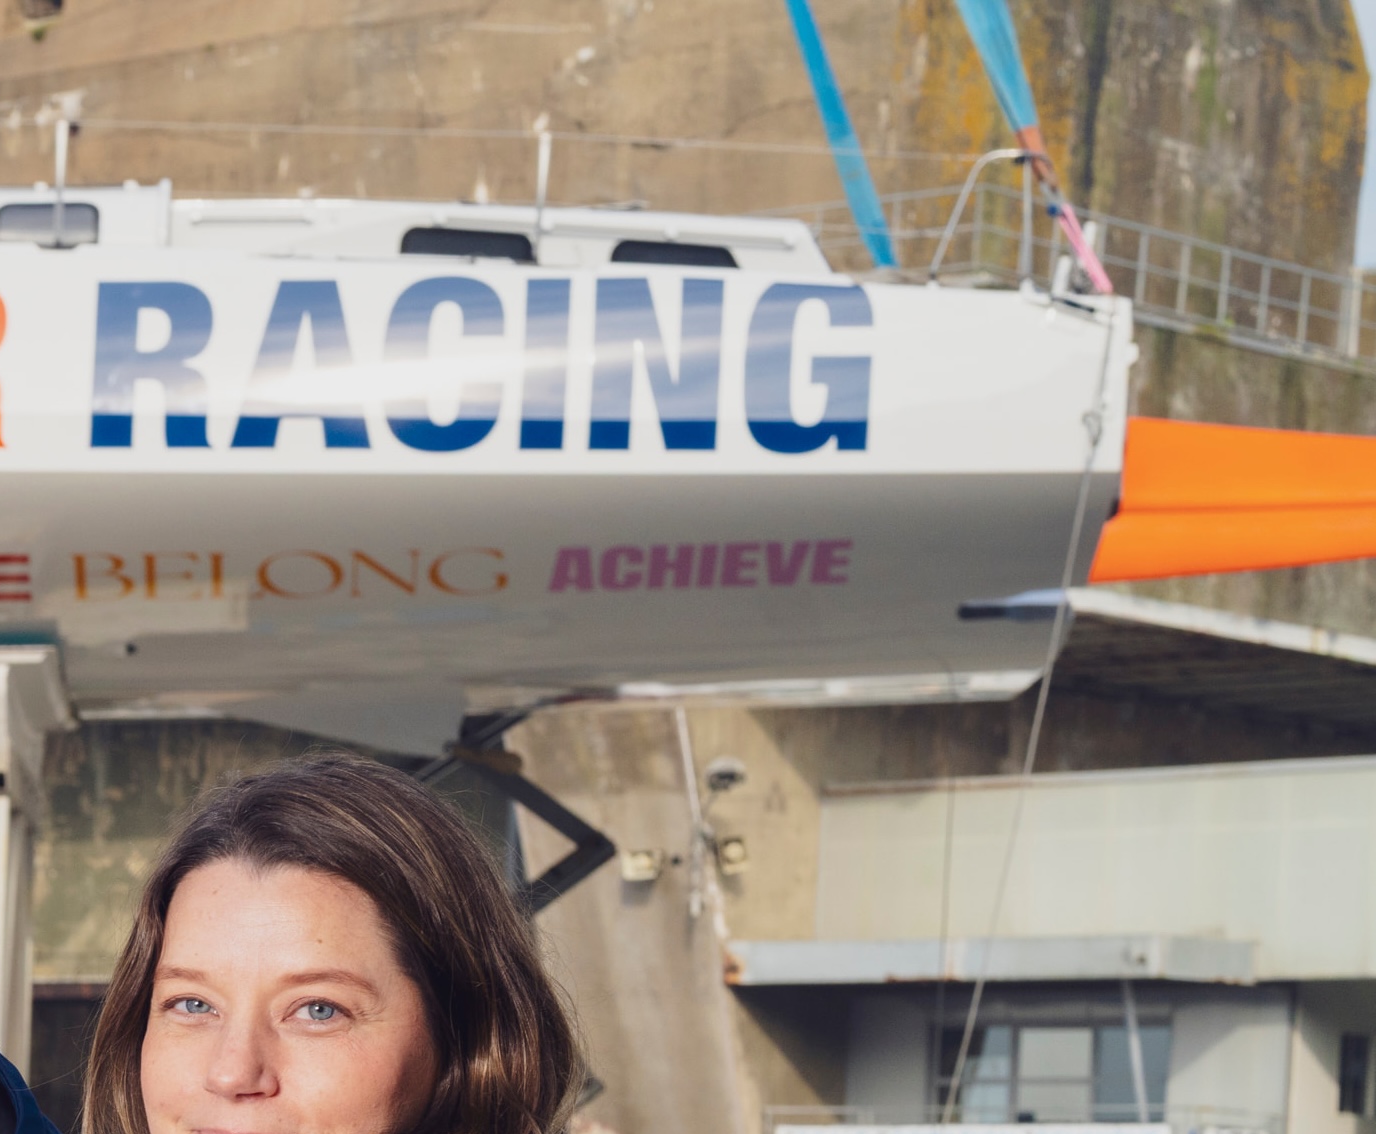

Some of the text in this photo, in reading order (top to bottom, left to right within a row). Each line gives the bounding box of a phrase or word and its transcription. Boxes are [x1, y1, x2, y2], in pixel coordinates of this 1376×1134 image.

[88, 276, 875, 455] RACING
[70, 547, 510, 601] BELONG
[549, 539, 854, 593] ACHIEVE
